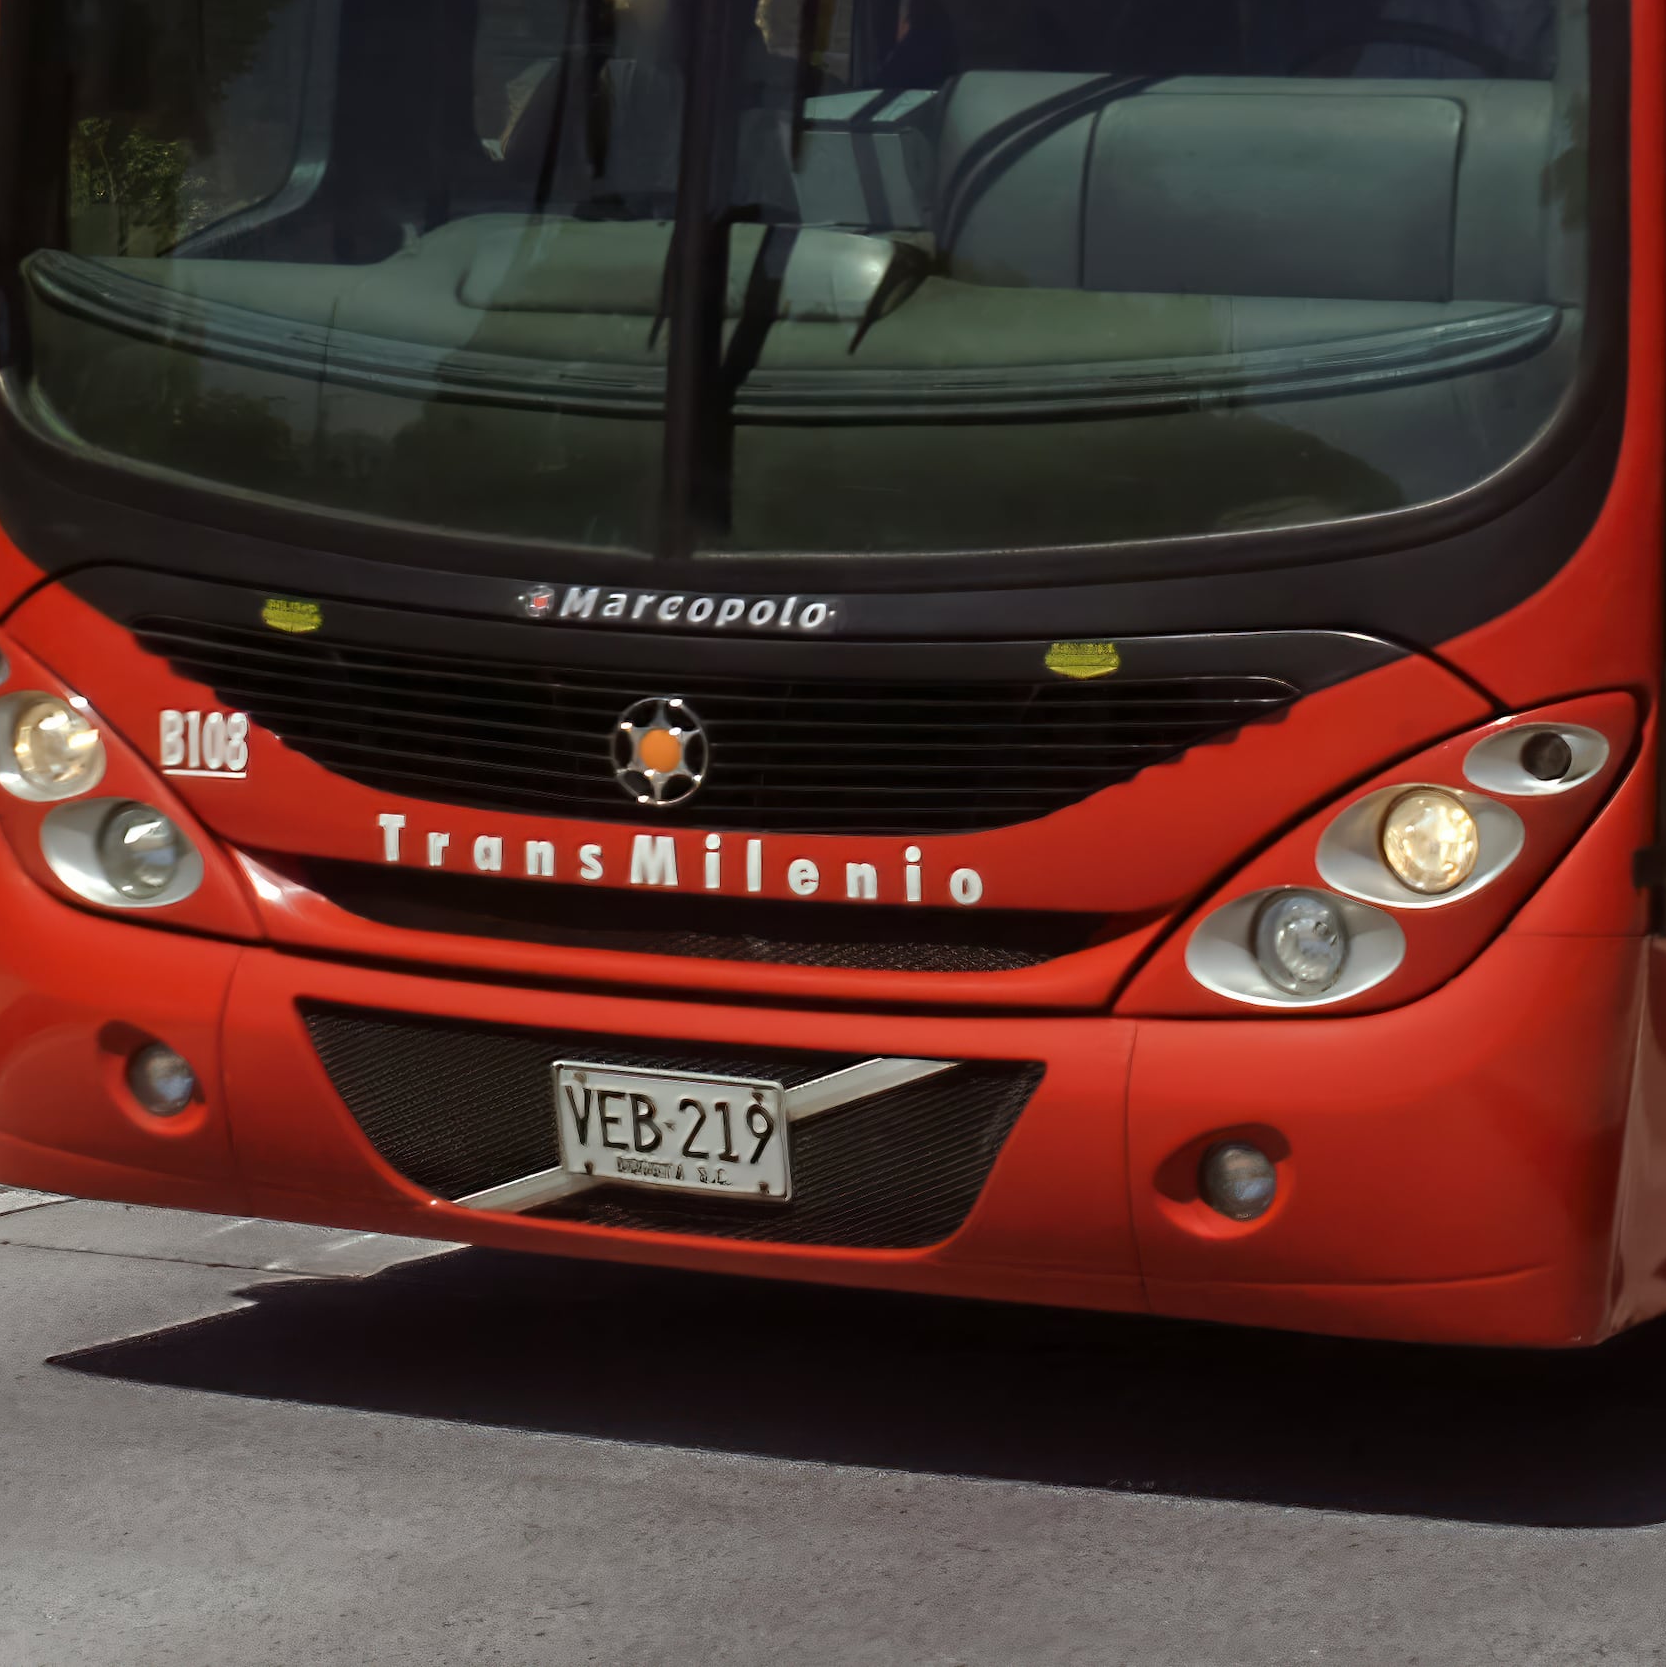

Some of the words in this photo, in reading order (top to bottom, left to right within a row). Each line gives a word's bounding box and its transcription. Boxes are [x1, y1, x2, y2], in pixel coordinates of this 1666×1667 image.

[559, 586, 828, 629] Marcopolo
[159, 709, 249, 771] B108
[377, 812, 986, 906] TransMilenio
